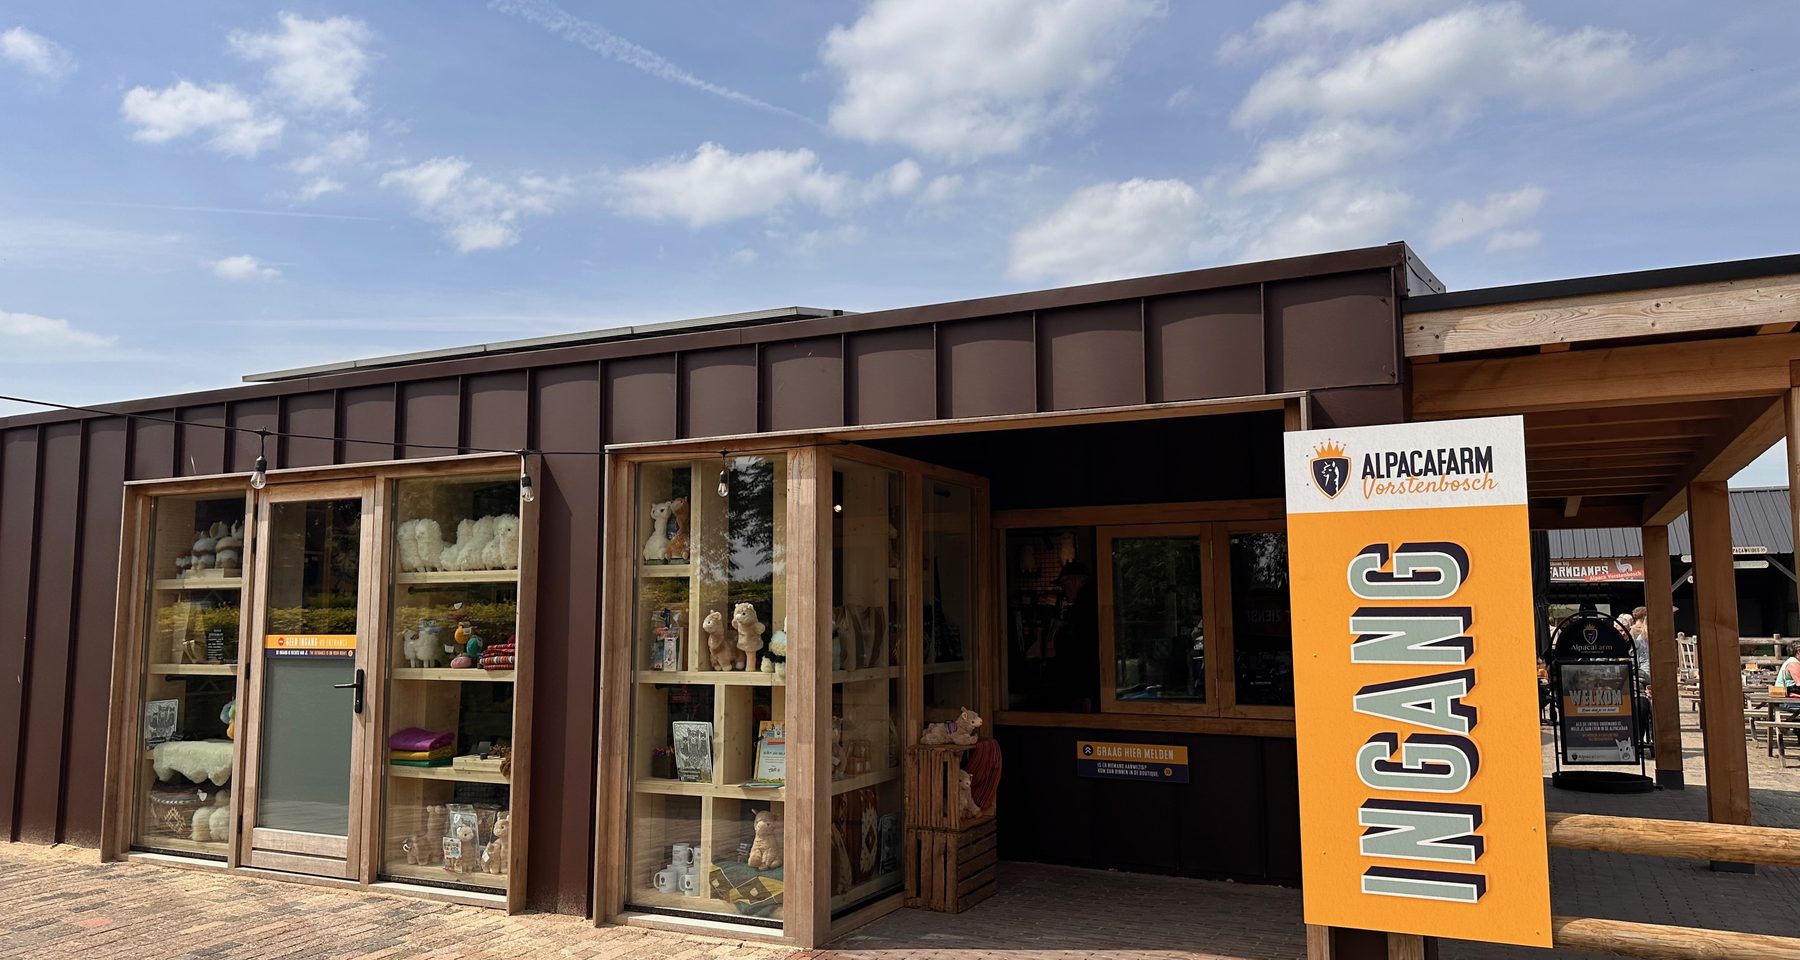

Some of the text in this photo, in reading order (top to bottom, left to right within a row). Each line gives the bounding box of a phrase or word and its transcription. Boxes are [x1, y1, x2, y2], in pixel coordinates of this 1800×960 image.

[1361, 446, 1494, 479] ALPACAFARM
[1363, 471, 1499, 500] Vorstenbosch
[1569, 689, 1622, 705] WELKOM
[1347, 541, 1487, 904] INGANG
[1096, 746, 1174, 760] GRAAG HIER MELDEN
